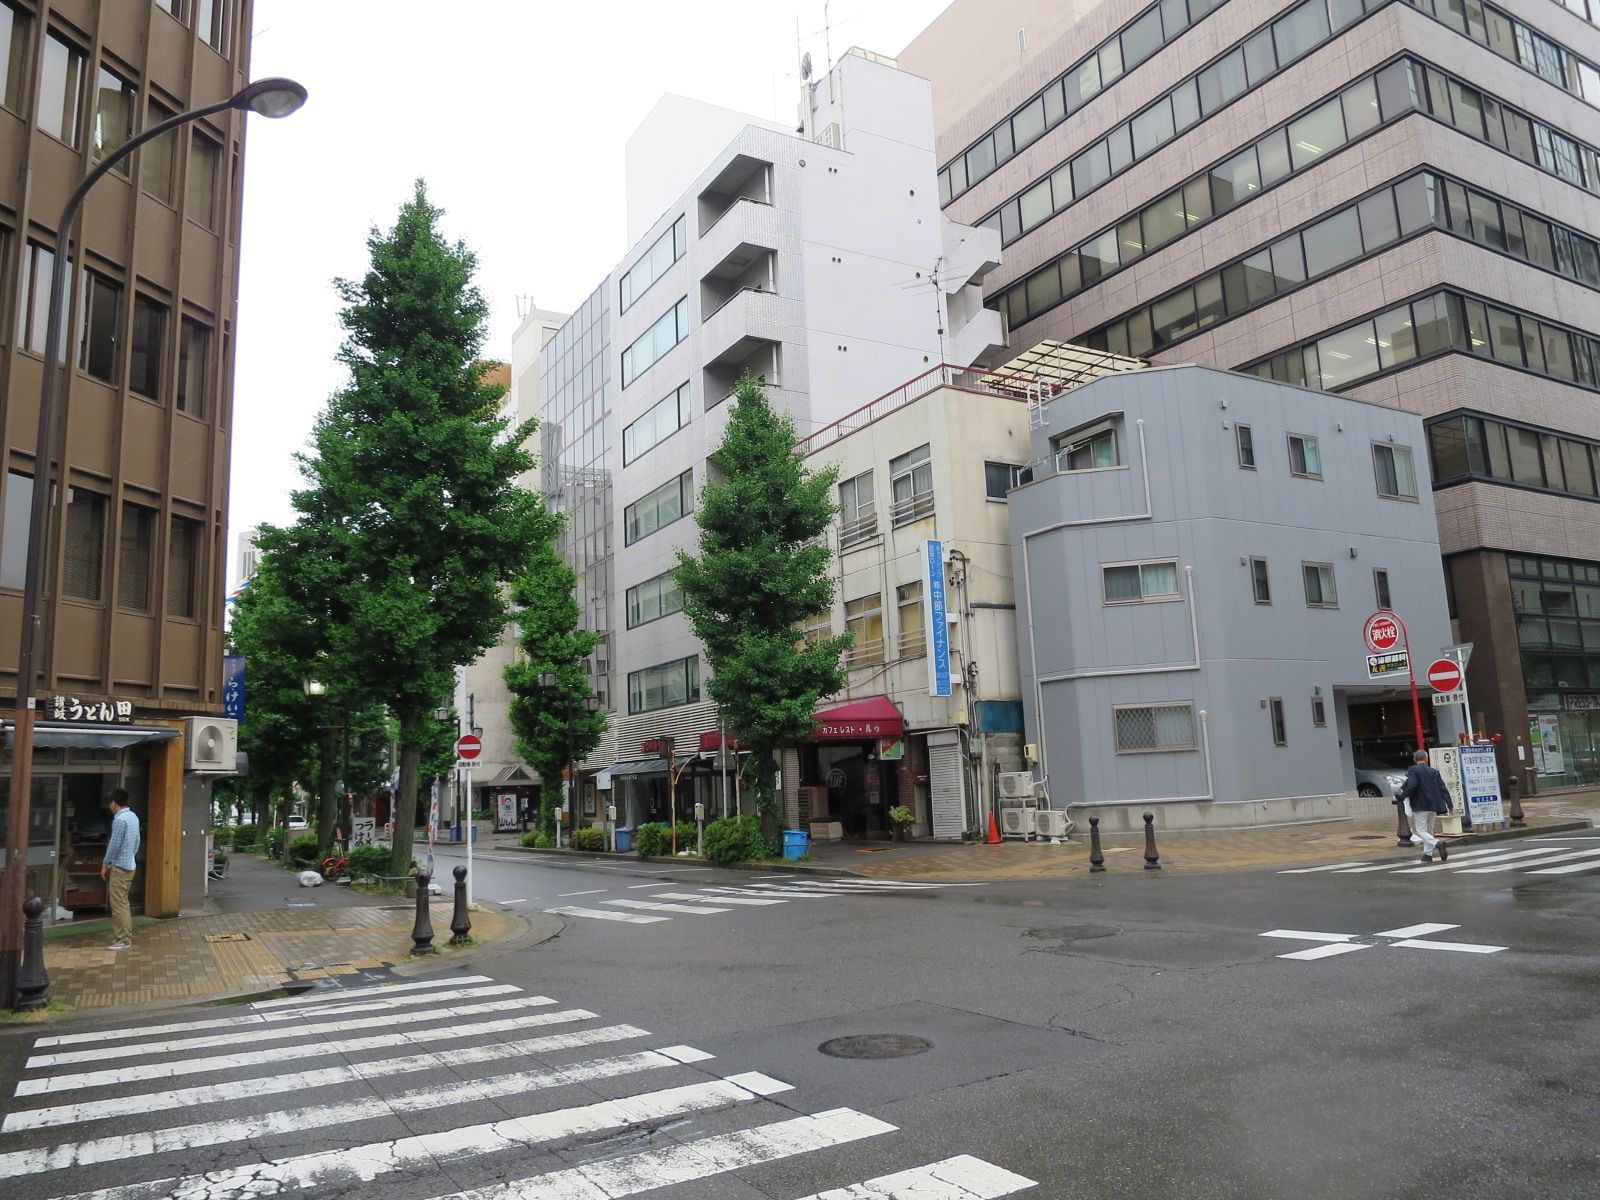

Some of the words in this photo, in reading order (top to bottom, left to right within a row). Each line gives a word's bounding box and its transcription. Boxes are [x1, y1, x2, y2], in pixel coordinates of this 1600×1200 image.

[1372, 626, 1396, 641] 消火栓
[354, 823, 365, 848] つけめ
[364, 820, 374, 846] ラーメ
